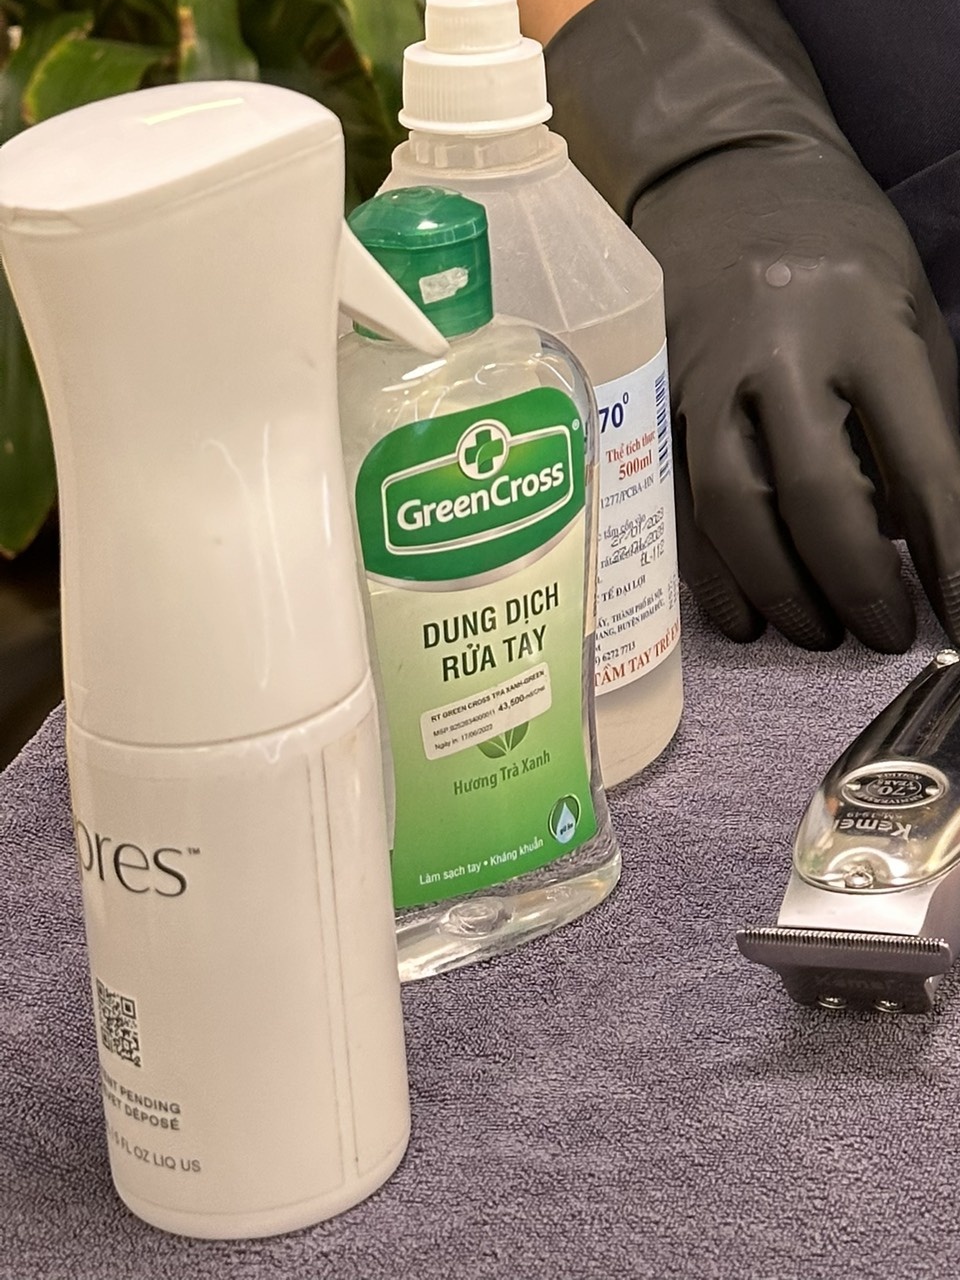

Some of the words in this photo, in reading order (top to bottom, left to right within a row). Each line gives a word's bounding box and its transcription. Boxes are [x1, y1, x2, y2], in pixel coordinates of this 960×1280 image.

[618, 449, 653, 481] 500ml
[396, 461, 565, 531] GreenCross
[423, 605, 497, 649] DUNG
[505, 581, 560, 625] DỊCH
[442, 641, 498, 683] RỬA
[502, 624, 548, 664] TAY
[627, 647, 652, 674] TAY
[453, 773, 498, 796] Hương
[521, 750, 551, 775] Xanh
[419, 873, 441, 885] Làm
[443, 865, 466, 880] sạch
[467, 861, 482, 873] tay
[489, 850, 518, 866] Kháng
[120, 1085, 181, 1116] PENDING
[124, 1102, 181, 1131] DÉPOSÉ
[133, 1145, 151, 1163] OZ
[153, 1152, 176, 1171] LIQ
[180, 1158, 201, 1173] US
